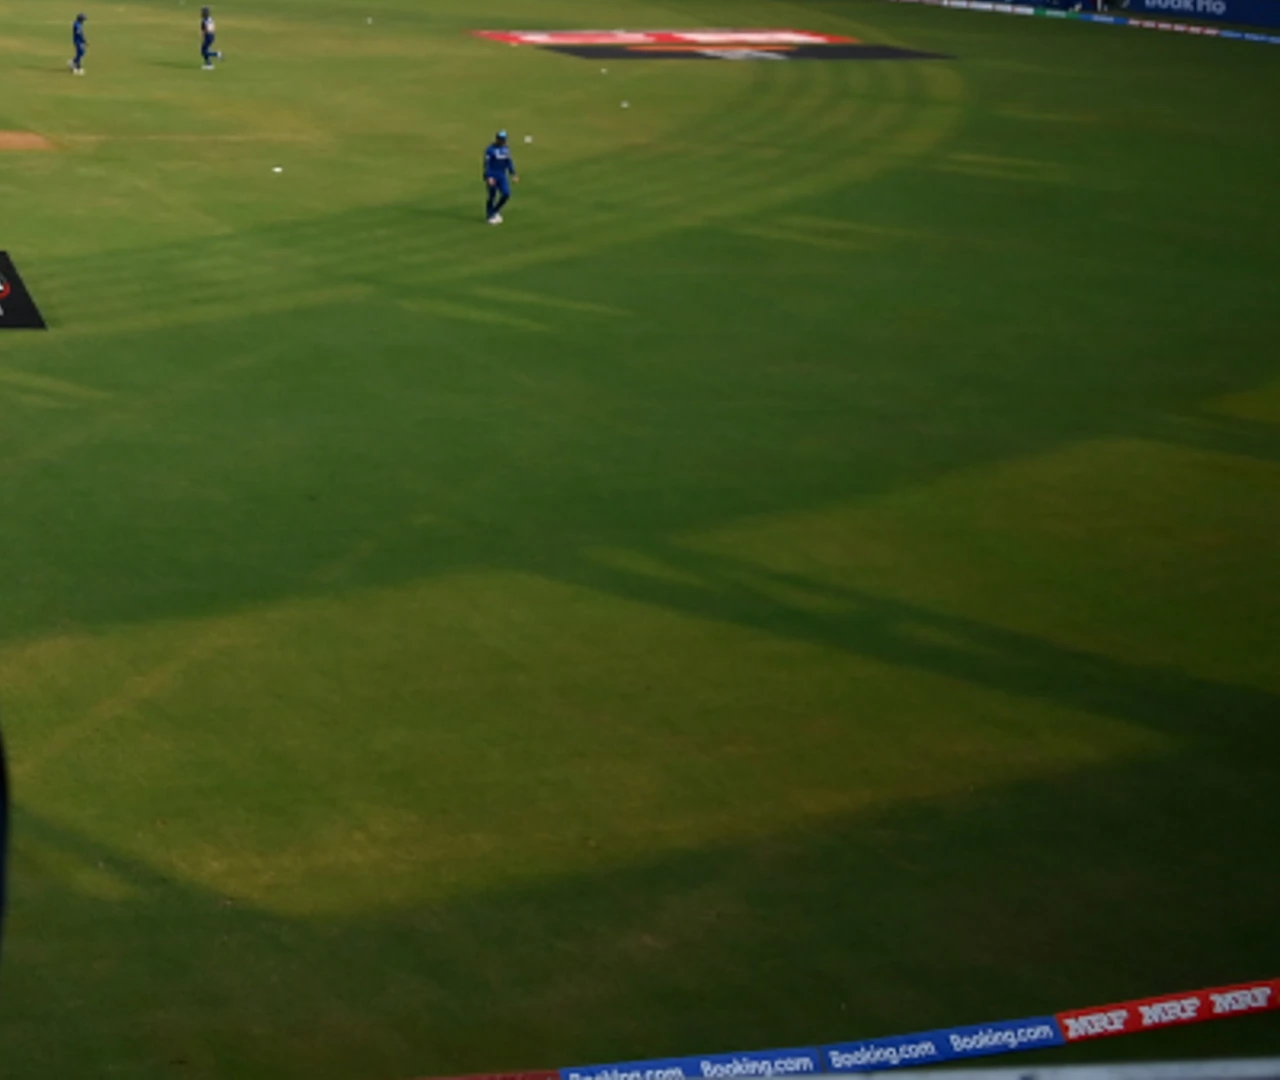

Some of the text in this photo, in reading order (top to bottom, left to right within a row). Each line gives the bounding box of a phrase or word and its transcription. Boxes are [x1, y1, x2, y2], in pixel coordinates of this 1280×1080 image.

[1138, 997, 1202, 1026] MRF
[1209, 986, 1272, 1013] MRF
[949, 1024, 1054, 1052] Booking.com
[1064, 1009, 1130, 1039] MRF
[699, 1056, 814, 1078] Booking.com
[828, 1038, 938, 1069] Booking.com
